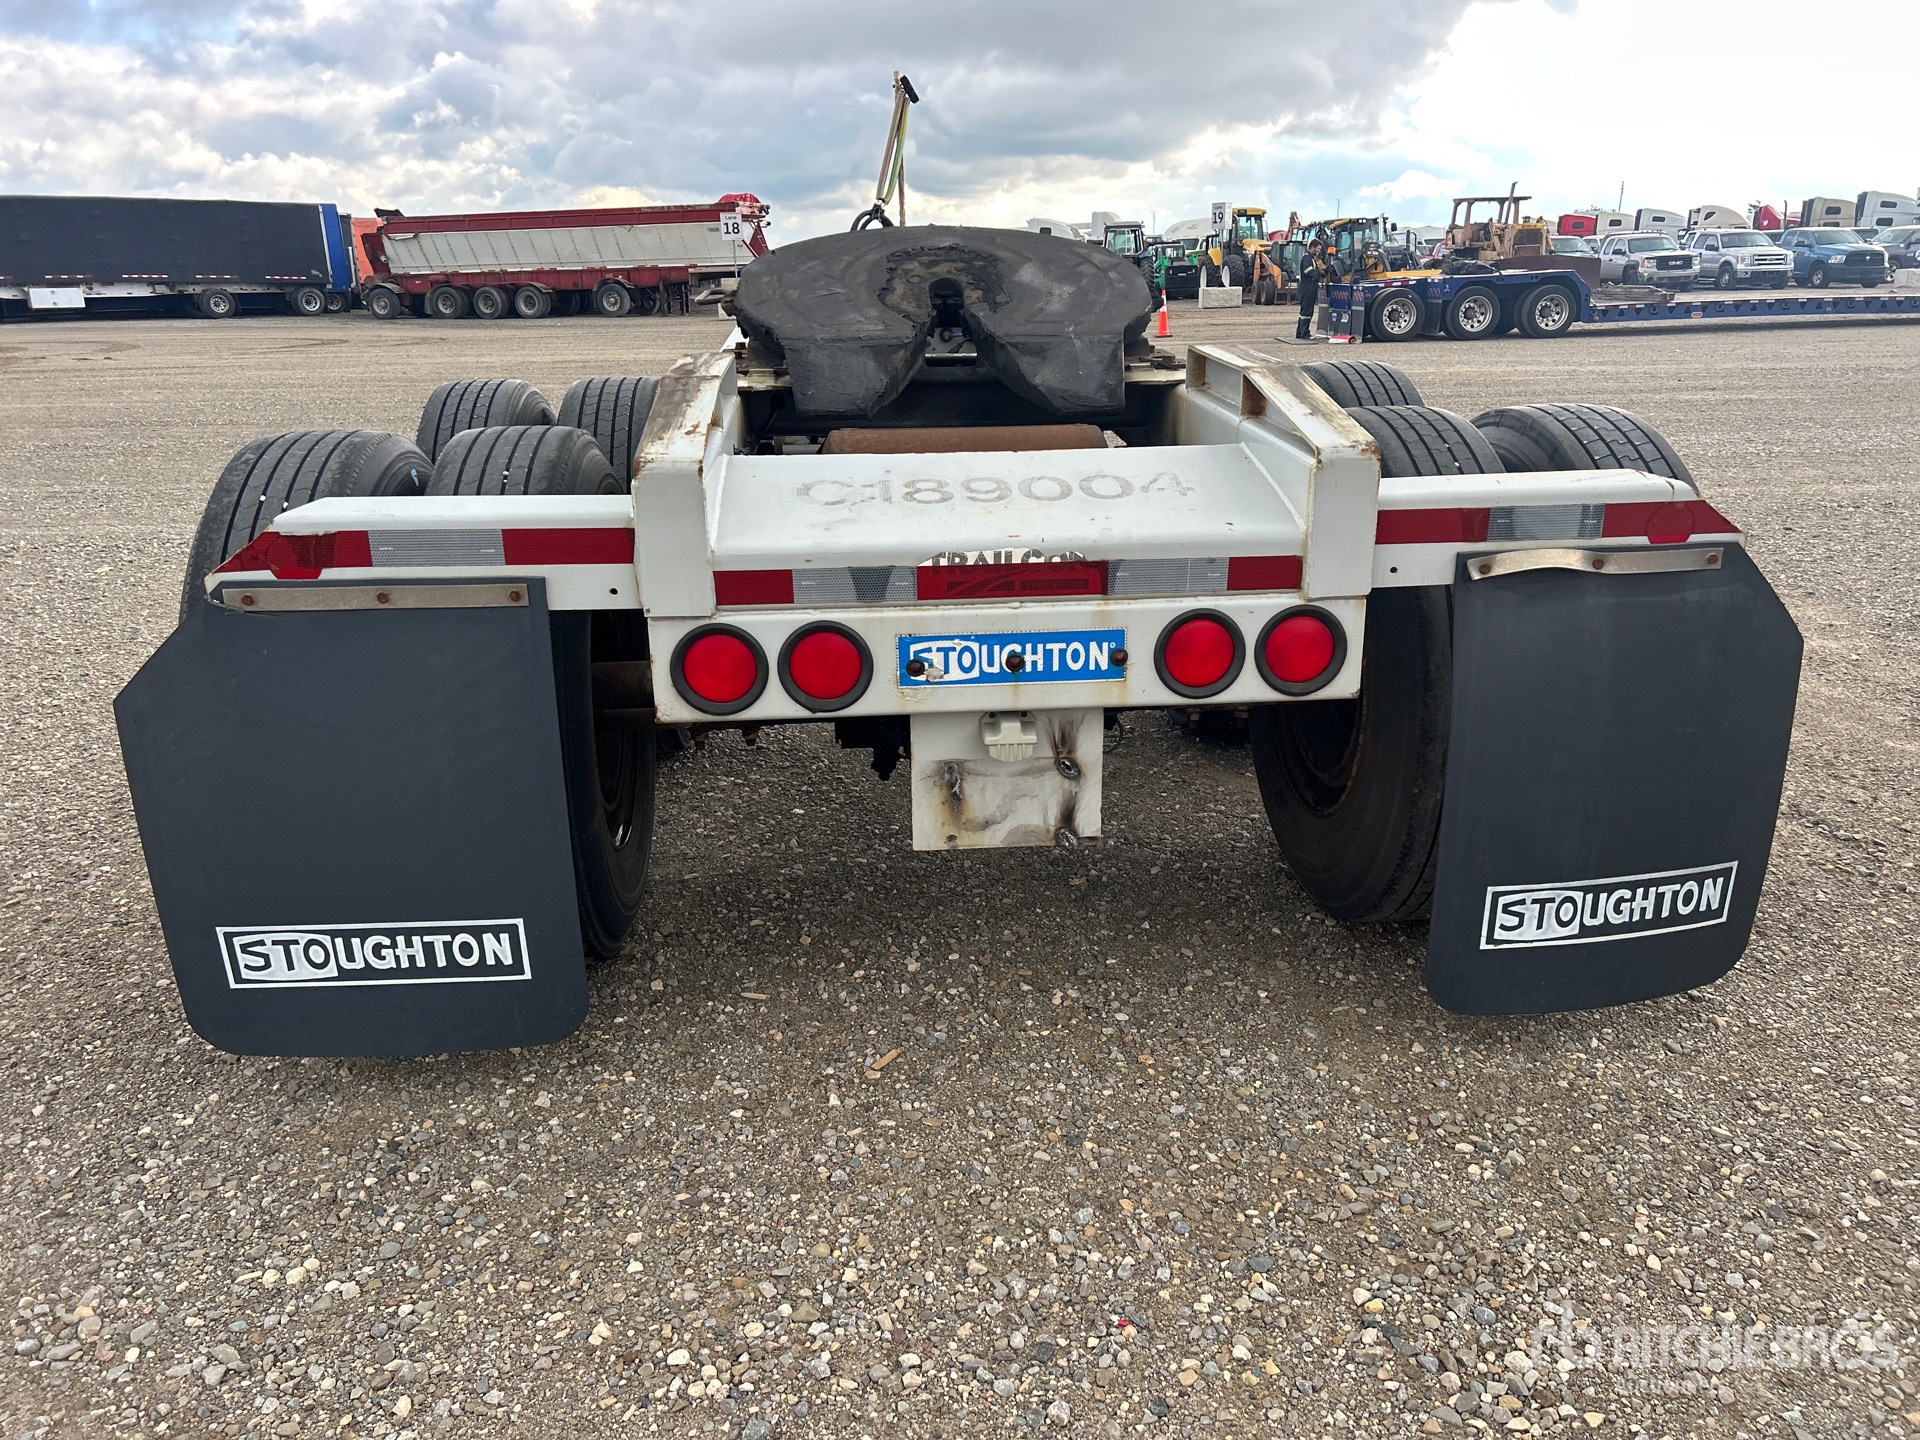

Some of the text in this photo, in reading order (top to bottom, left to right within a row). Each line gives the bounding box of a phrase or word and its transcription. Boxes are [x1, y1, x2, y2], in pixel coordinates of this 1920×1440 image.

[723, 221, 740, 235] 18
[1212, 211, 1224, 224] 19
[1498, 876, 1725, 931] STOUGHTON
[238, 932, 514, 972] STOUGHTON
